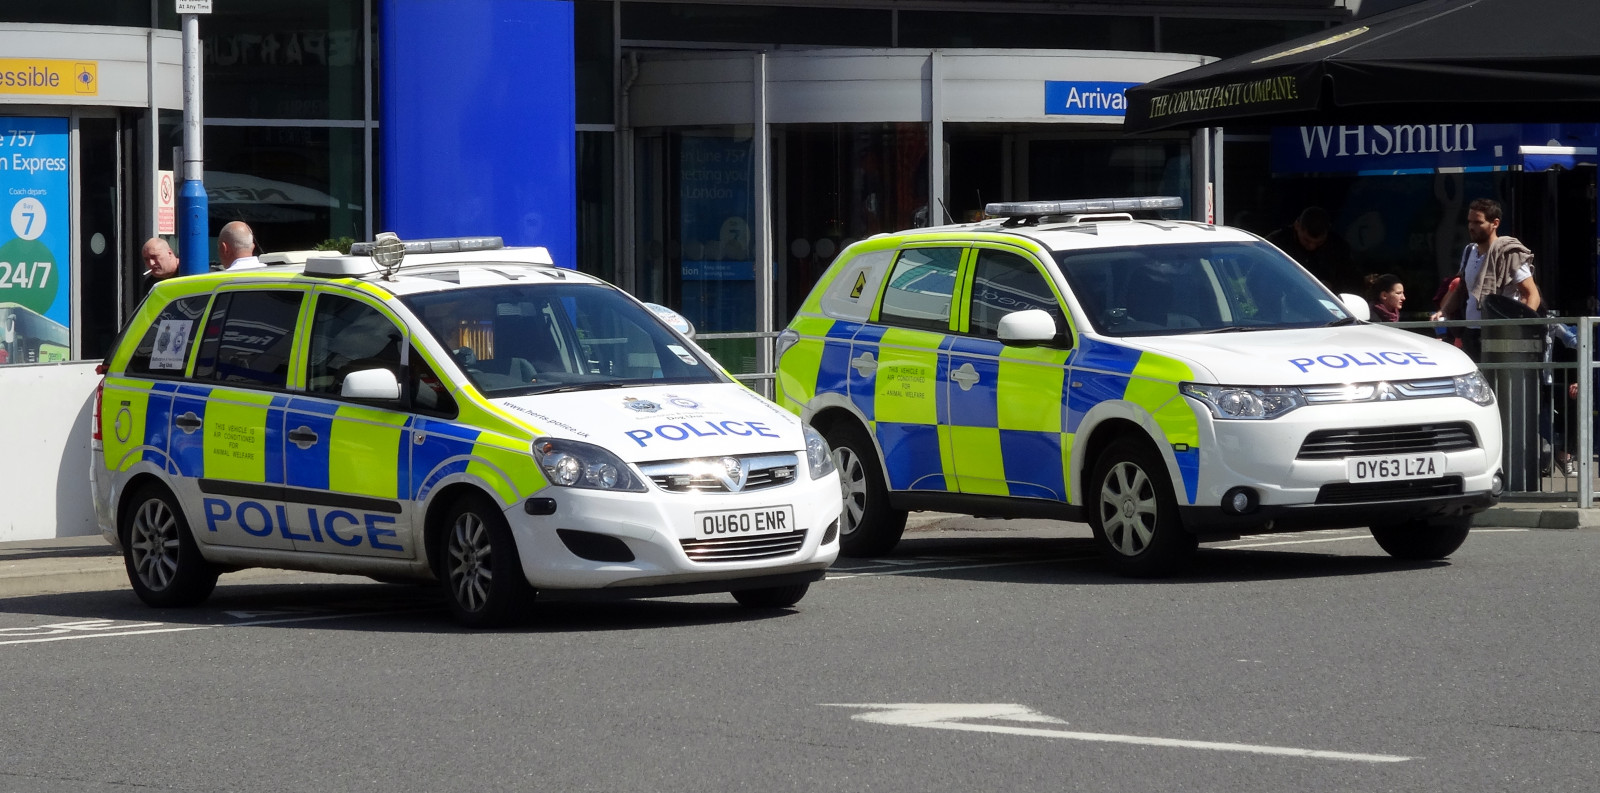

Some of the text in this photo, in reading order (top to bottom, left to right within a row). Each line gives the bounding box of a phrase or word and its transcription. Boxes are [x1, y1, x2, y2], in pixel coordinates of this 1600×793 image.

[1149, 95, 1169, 119] THE
[1168, 87, 1213, 115] CORNISH
[1210, 83, 1245, 108] PASTY
[1243, 76, 1293, 104] COMPANY
[8, 130, 36, 147] 757
[1300, 123, 1476, 159] WHSmith
[13, 153, 66, 175] Express
[22, 212, 35, 236] 7
[0, 262, 52, 288] 24/7
[889, 366, 899, 374] THIS
[900, 367, 919, 375] VEHICLE
[1288, 351, 1438, 374] POLICE
[886, 390, 926, 400] ANIMAL WELFARE
[215, 422, 226, 431] THIS
[228, 425, 248, 434] VEHICLE
[503, 401, 590, 438] www.herts.police.uk
[223, 432, 256, 444] CONDITIONED
[228, 441, 240, 449] FOR
[624, 420, 781, 448] POLICE
[213, 448, 255, 461] ANIMAL WELFARE
[1356, 457, 1436, 479] OY63 LZA
[203, 497, 404, 552] POLICE
[703, 510, 786, 535] OU60 ENR
